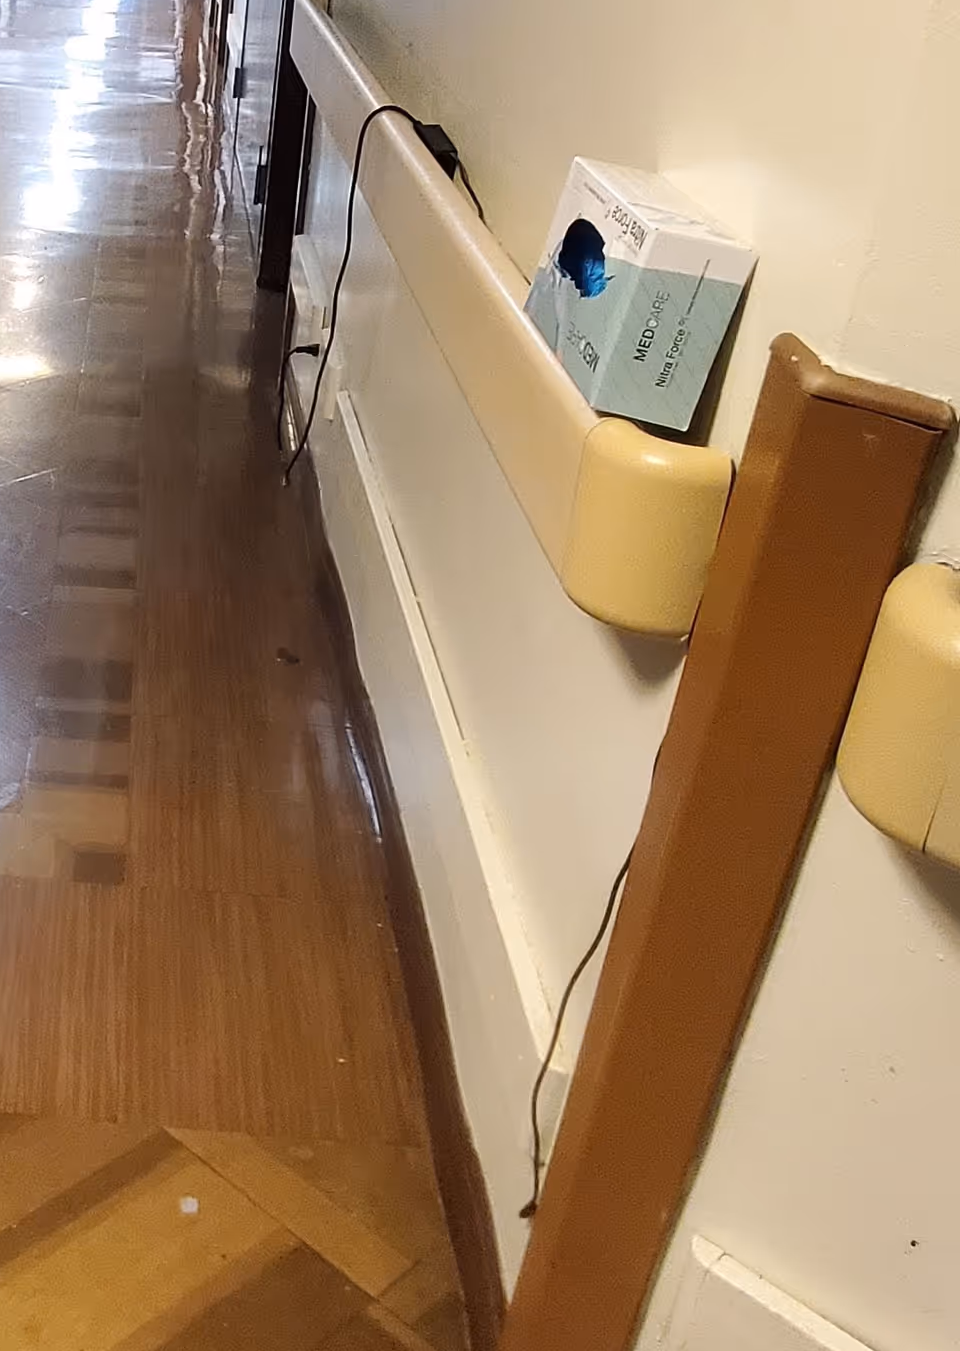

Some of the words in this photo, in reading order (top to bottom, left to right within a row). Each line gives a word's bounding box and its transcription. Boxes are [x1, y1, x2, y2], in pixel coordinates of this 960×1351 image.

[612, 204, 633, 234] Force
[630, 218, 648, 251] Nitra
[633, 290, 670, 362] MEDCARE
[655, 361, 674, 388] Nitra
[666, 328, 686, 360] Force
